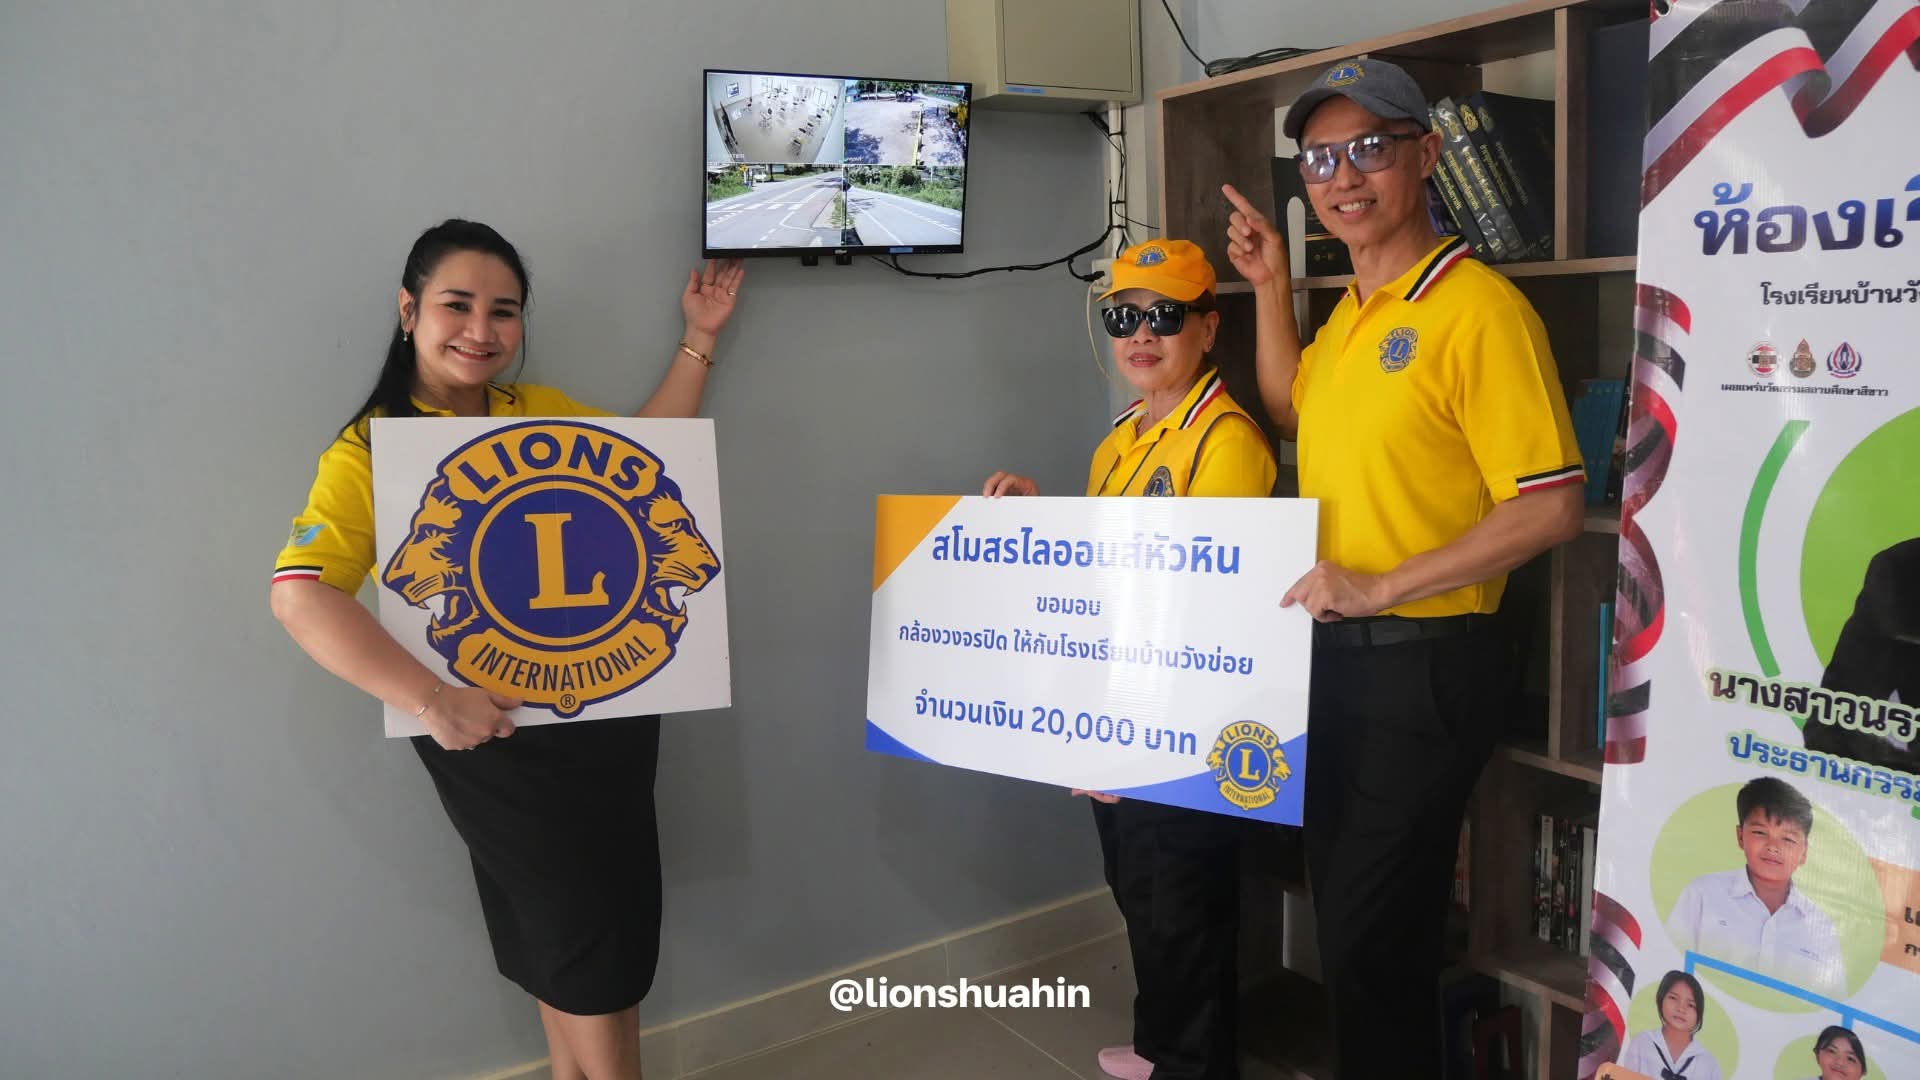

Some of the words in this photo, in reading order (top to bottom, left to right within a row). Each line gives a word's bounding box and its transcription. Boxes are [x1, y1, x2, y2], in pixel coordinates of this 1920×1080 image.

[1760, 279, 1920, 305] โรงเรียนบ้านวั
[457, 432, 648, 494] LIONS
[524, 512, 609, 610] L
[1036, 595, 1102, 617] ขอมอบ
[470, 635, 658, 692] INTERNATIONAL
[899, 619, 1008, 651] กล้องวงจรปิด
[915, 688, 1024, 730] จำนวนเงิน
[1031, 706, 1135, 746] 20,000
[1145, 728, 1197, 756] บาท
[1710, 672, 1920, 737] นางสาวนร
[1226, 723, 1275, 746] LIONS
[1238, 748, 1260, 781] L
[1730, 734, 1920, 803] ประธานกรร
